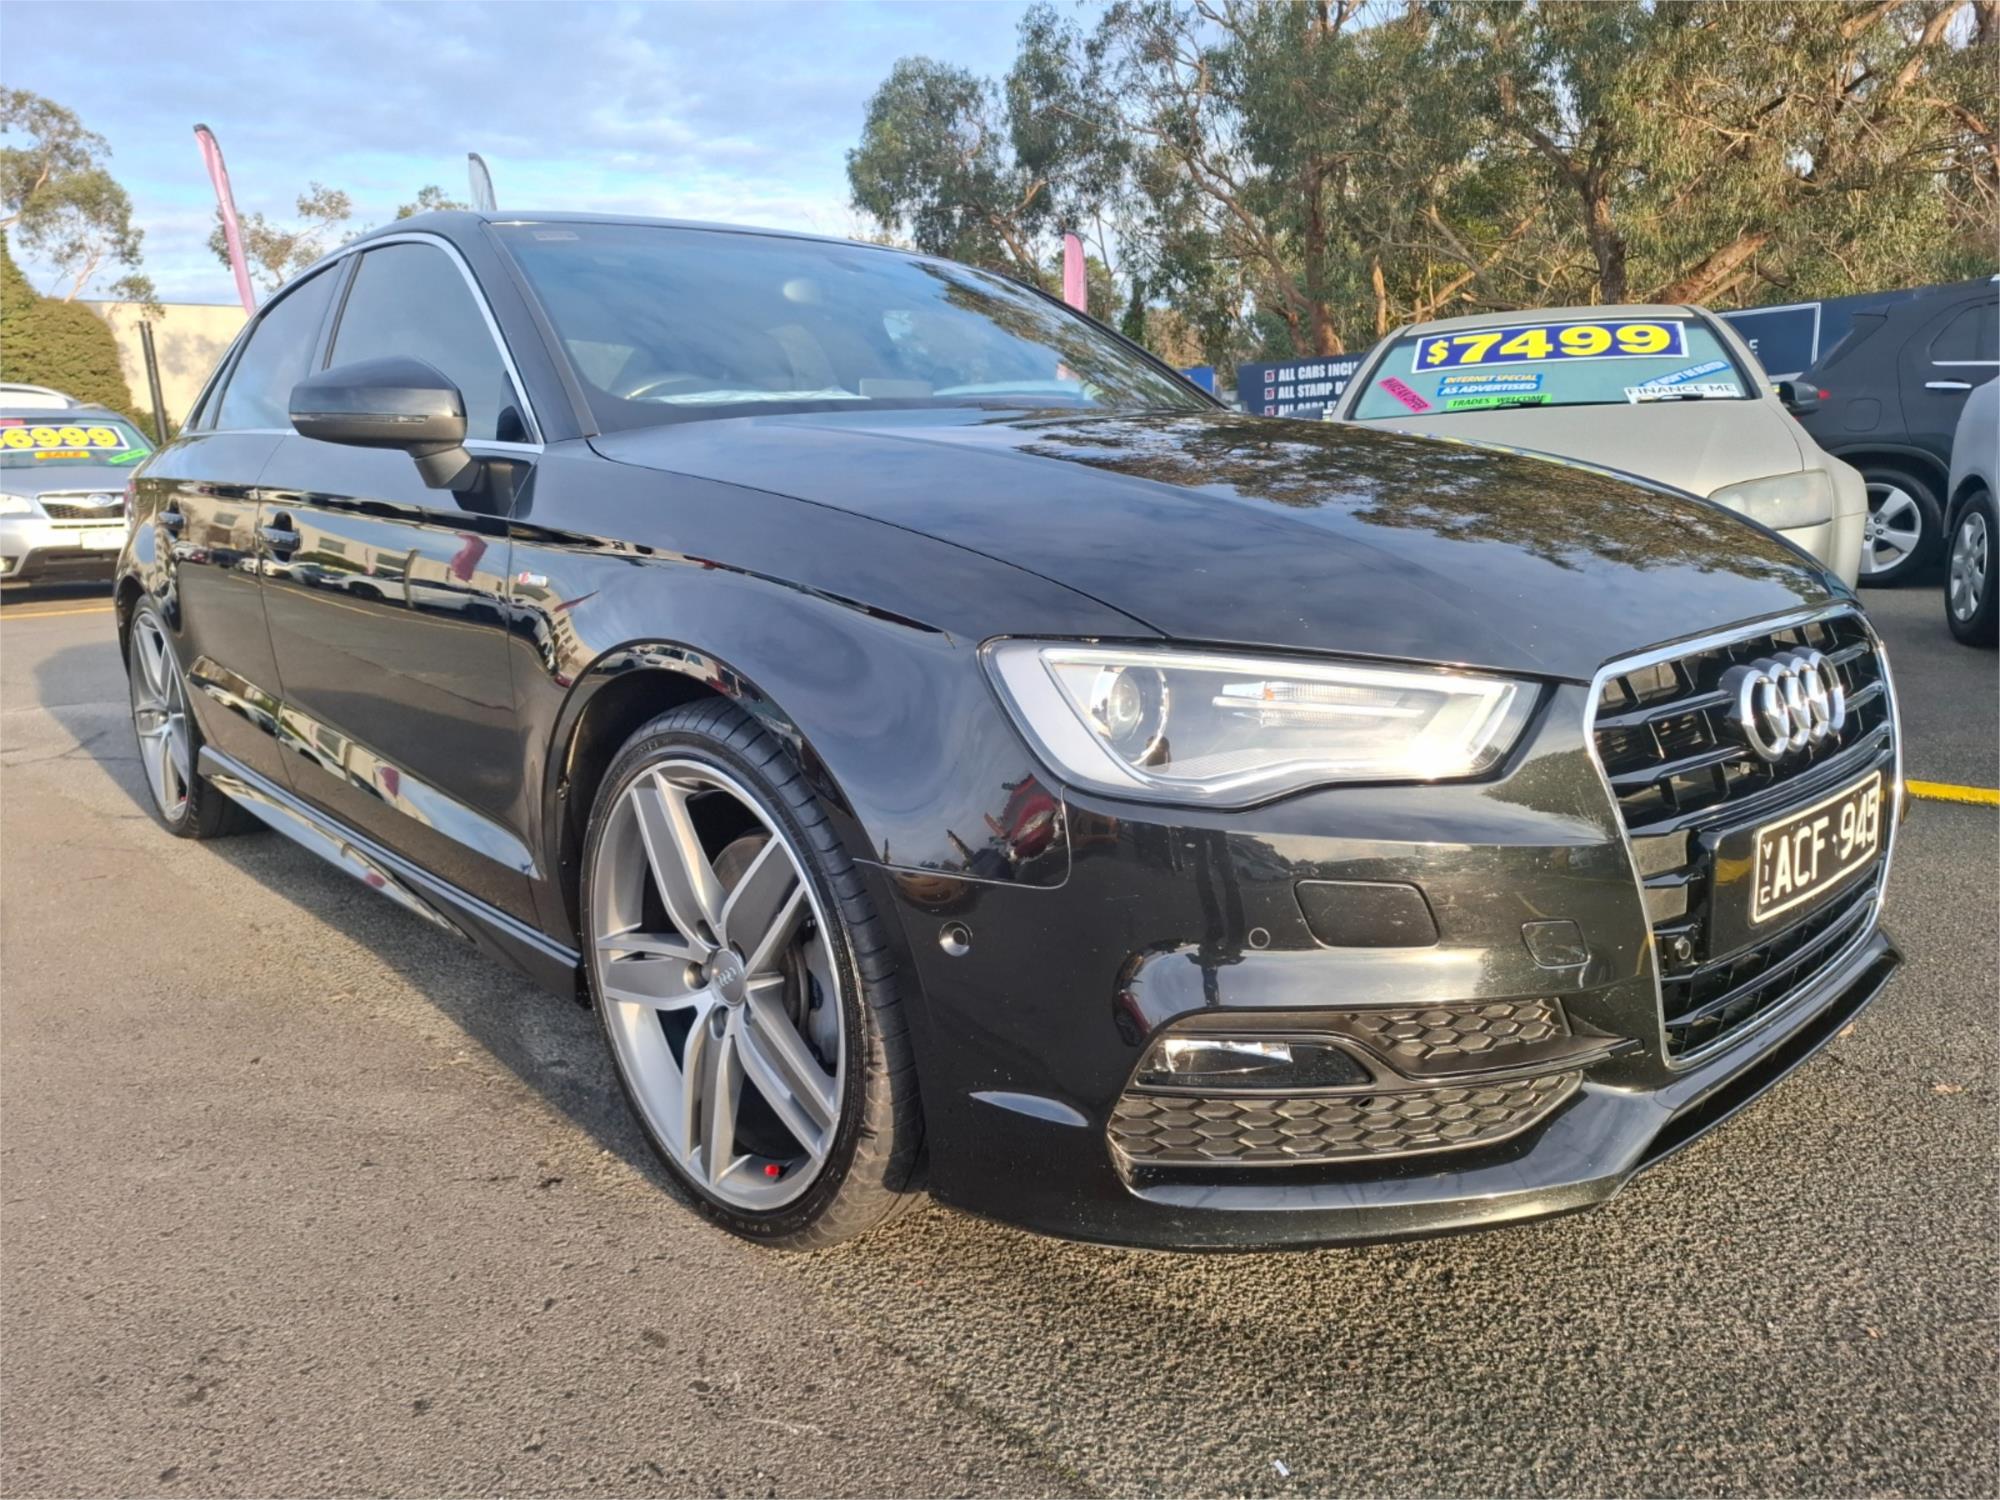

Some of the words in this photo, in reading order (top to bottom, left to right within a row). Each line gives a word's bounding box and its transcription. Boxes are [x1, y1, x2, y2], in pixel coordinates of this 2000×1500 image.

[1426, 325, 1671, 365] $7499
[1278, 368, 1295, 381] ALL
[1298, 365, 1325, 379] CARS
[1278, 386, 1295, 399] ALL
[1297, 382, 1333, 397] STAMP
[1441, 386, 1458, 394] AS
[1460, 383, 1538, 393] ADVERTISED
[1627, 385, 1701, 395] FINANCE
[1708, 384, 1737, 392] ME
[1452, 397, 1490, 407] TRADES
[0, 427, 118, 448] 6999
